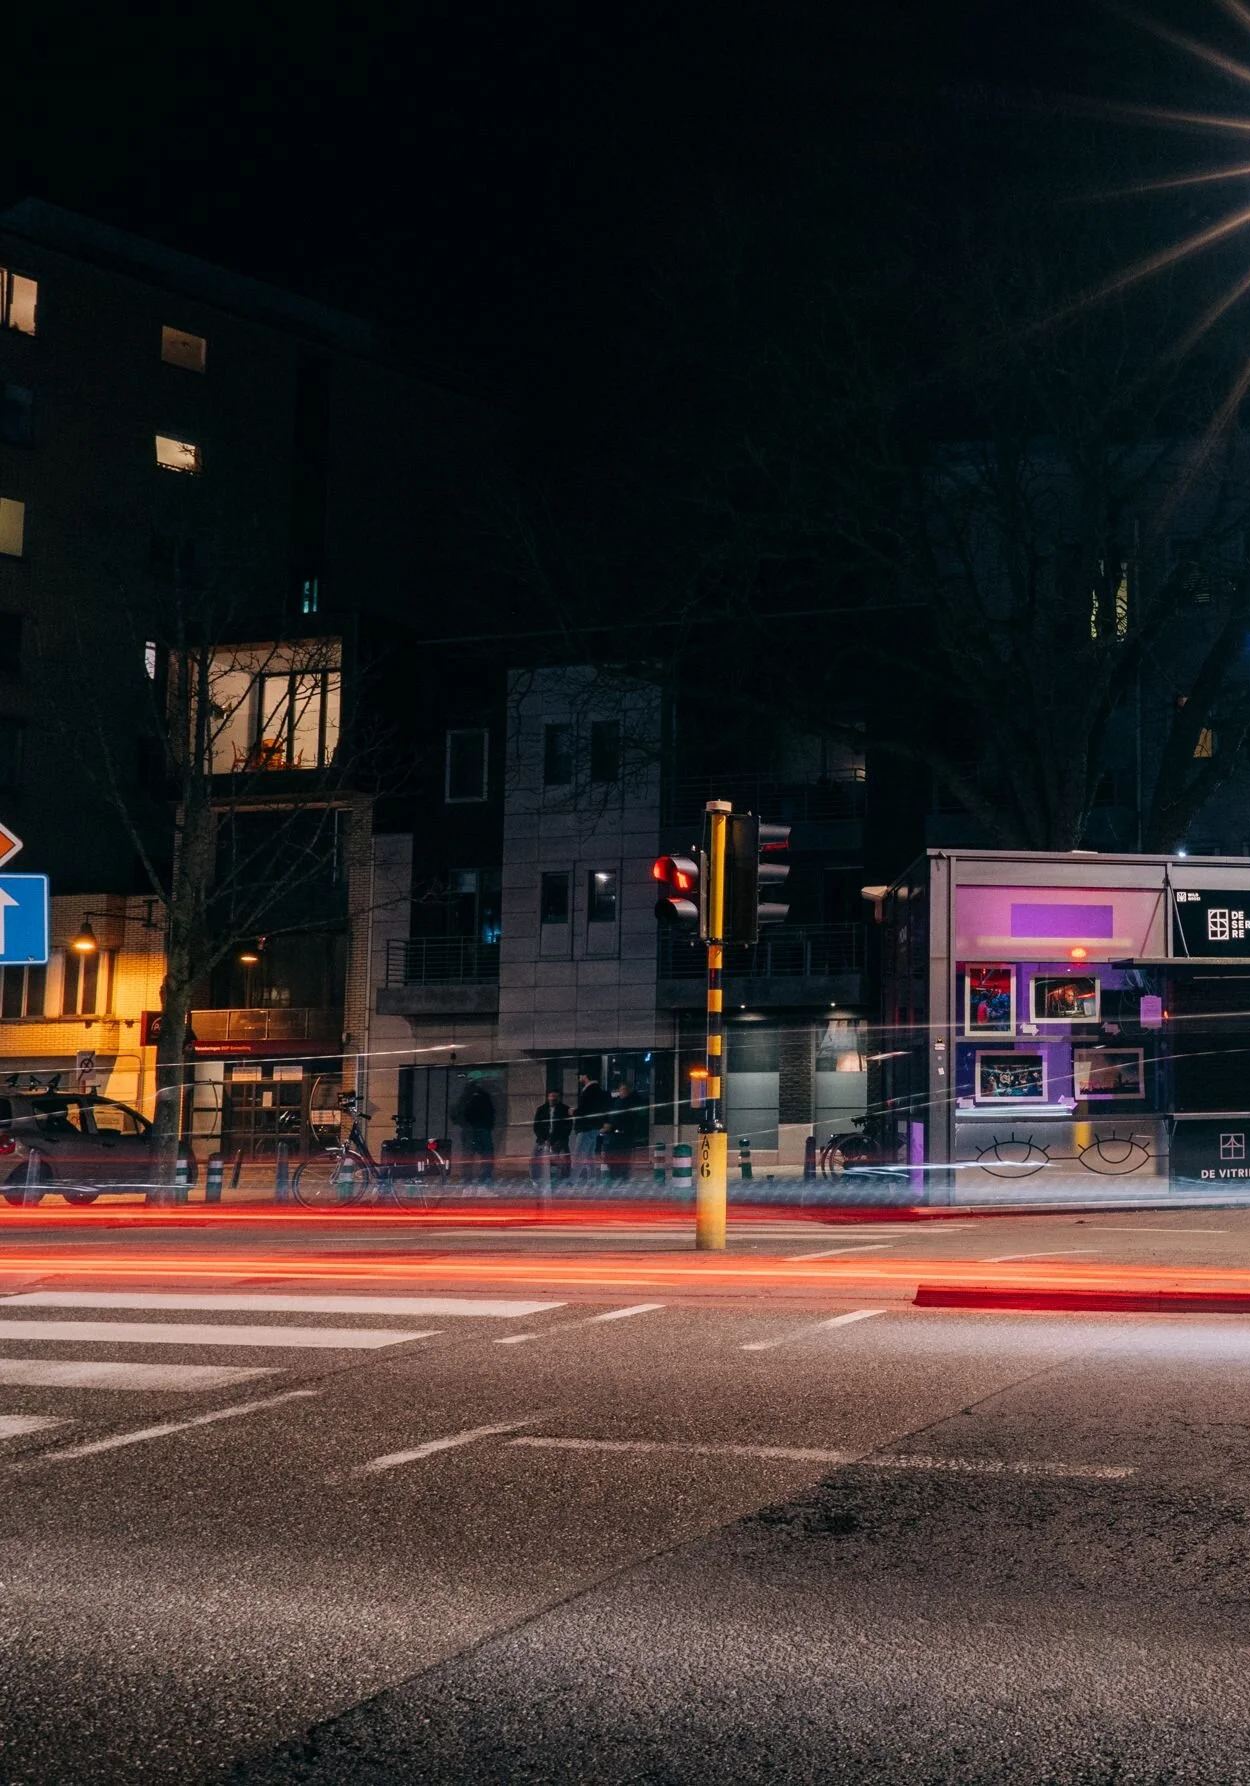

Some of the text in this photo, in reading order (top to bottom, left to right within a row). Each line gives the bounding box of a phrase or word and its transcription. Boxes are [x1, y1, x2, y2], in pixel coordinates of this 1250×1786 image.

[1231, 911, 1244, 920] DE
[1231, 929, 1245, 938] RE
[1201, 1169, 1216, 1179] DE
